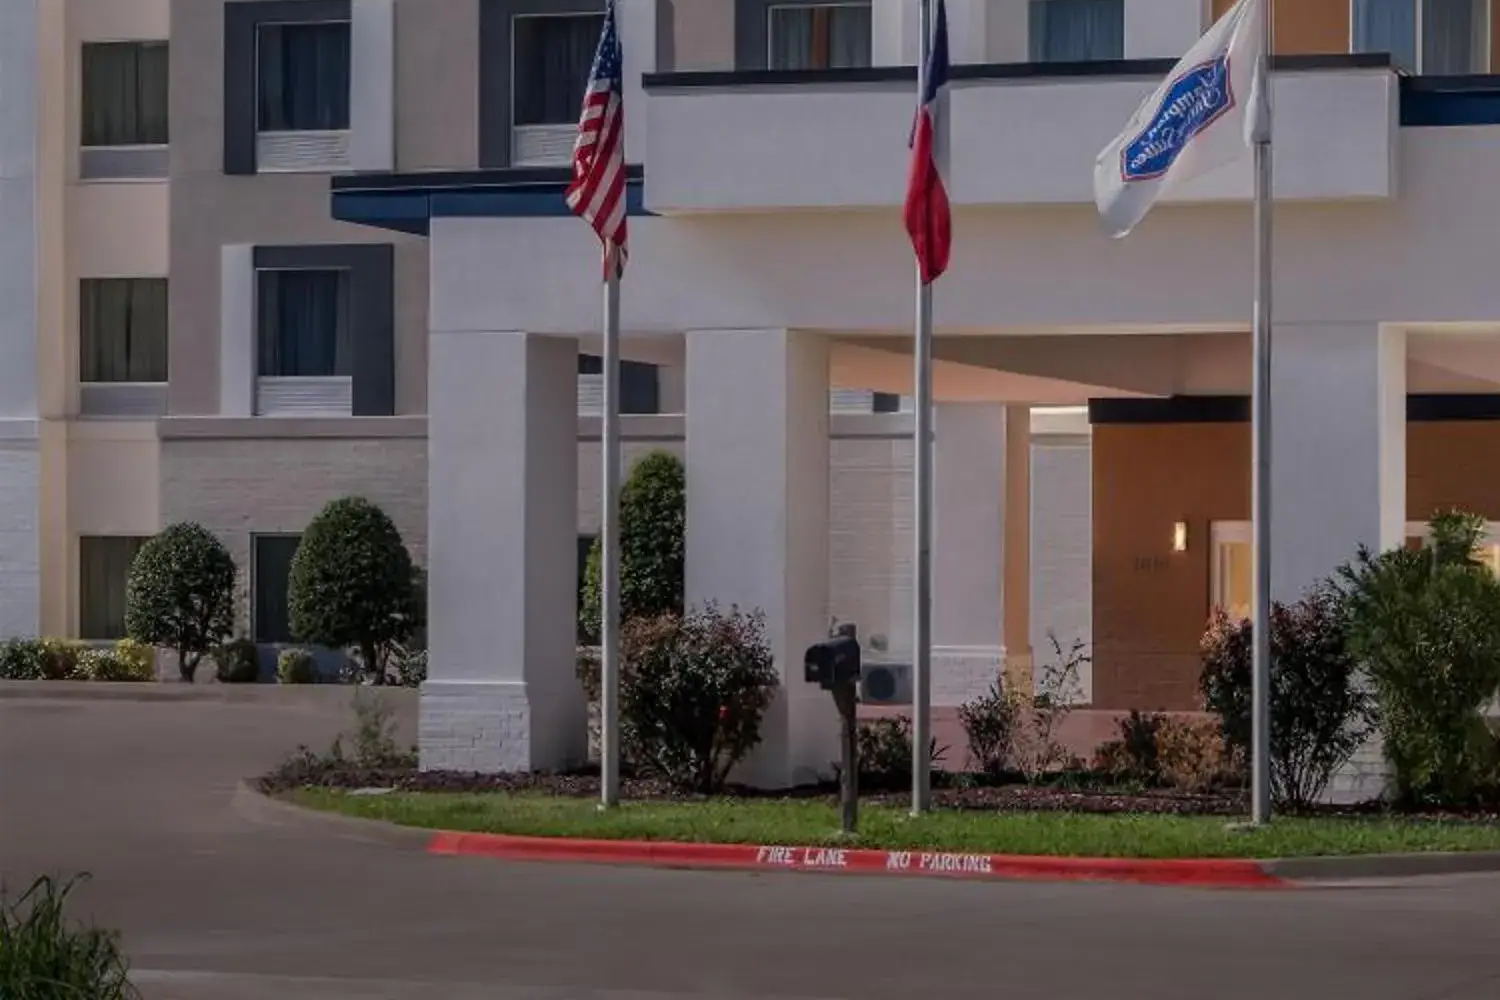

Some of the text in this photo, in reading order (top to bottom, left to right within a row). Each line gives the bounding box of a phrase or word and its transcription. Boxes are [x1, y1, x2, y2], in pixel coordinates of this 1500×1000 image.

[755, 846, 992, 873] FIRE LANE NO PARKING
